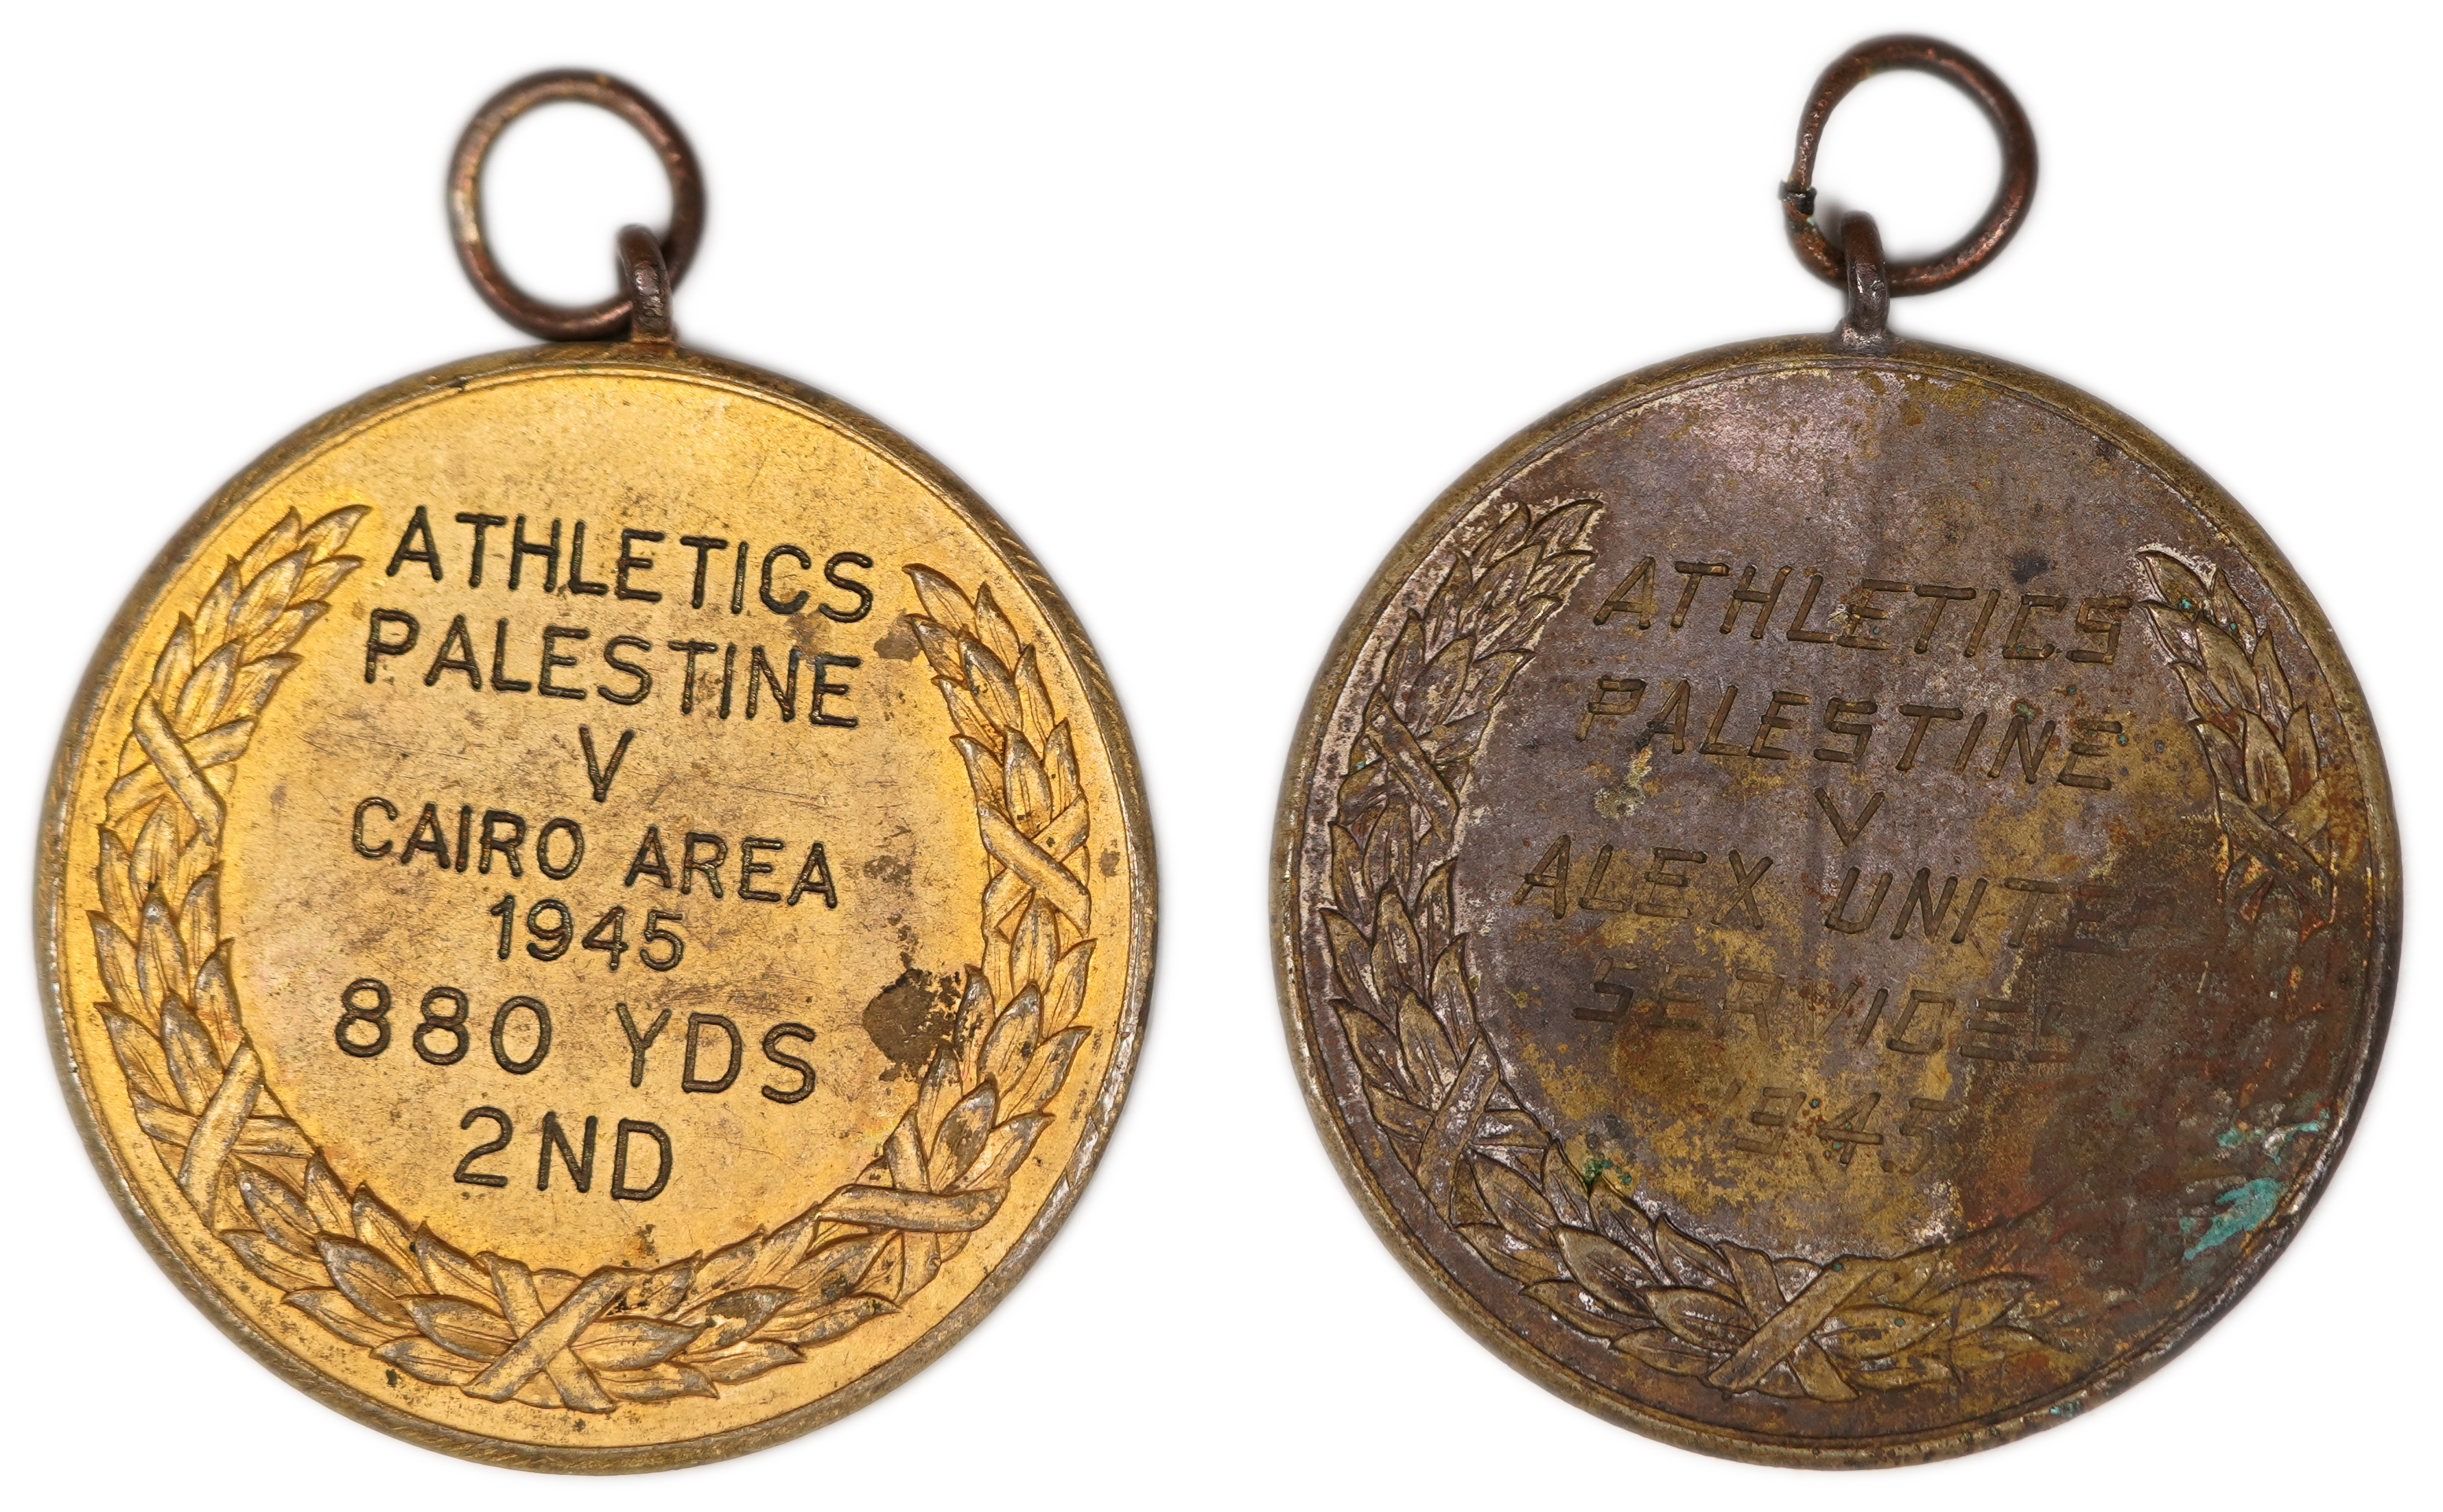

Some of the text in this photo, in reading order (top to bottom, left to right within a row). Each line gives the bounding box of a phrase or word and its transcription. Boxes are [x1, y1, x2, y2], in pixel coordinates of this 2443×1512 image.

[387, 506, 874, 623] ATHLETICS
[1593, 556, 2134, 663] ATHLETICS
[364, 608, 862, 728] PALESTINE
[579, 724, 636, 803] V
[1575, 674, 2124, 791] PALESTINE
[351, 796, 838, 908] CAIRO AREA
[1813, 786, 1885, 848] V
[490, 895, 685, 971] 1945
[1511, 833, 1774, 931] ALEX
[335, 978, 817, 1104] 880 YDS
[453, 1106, 672, 1201] 2ND
